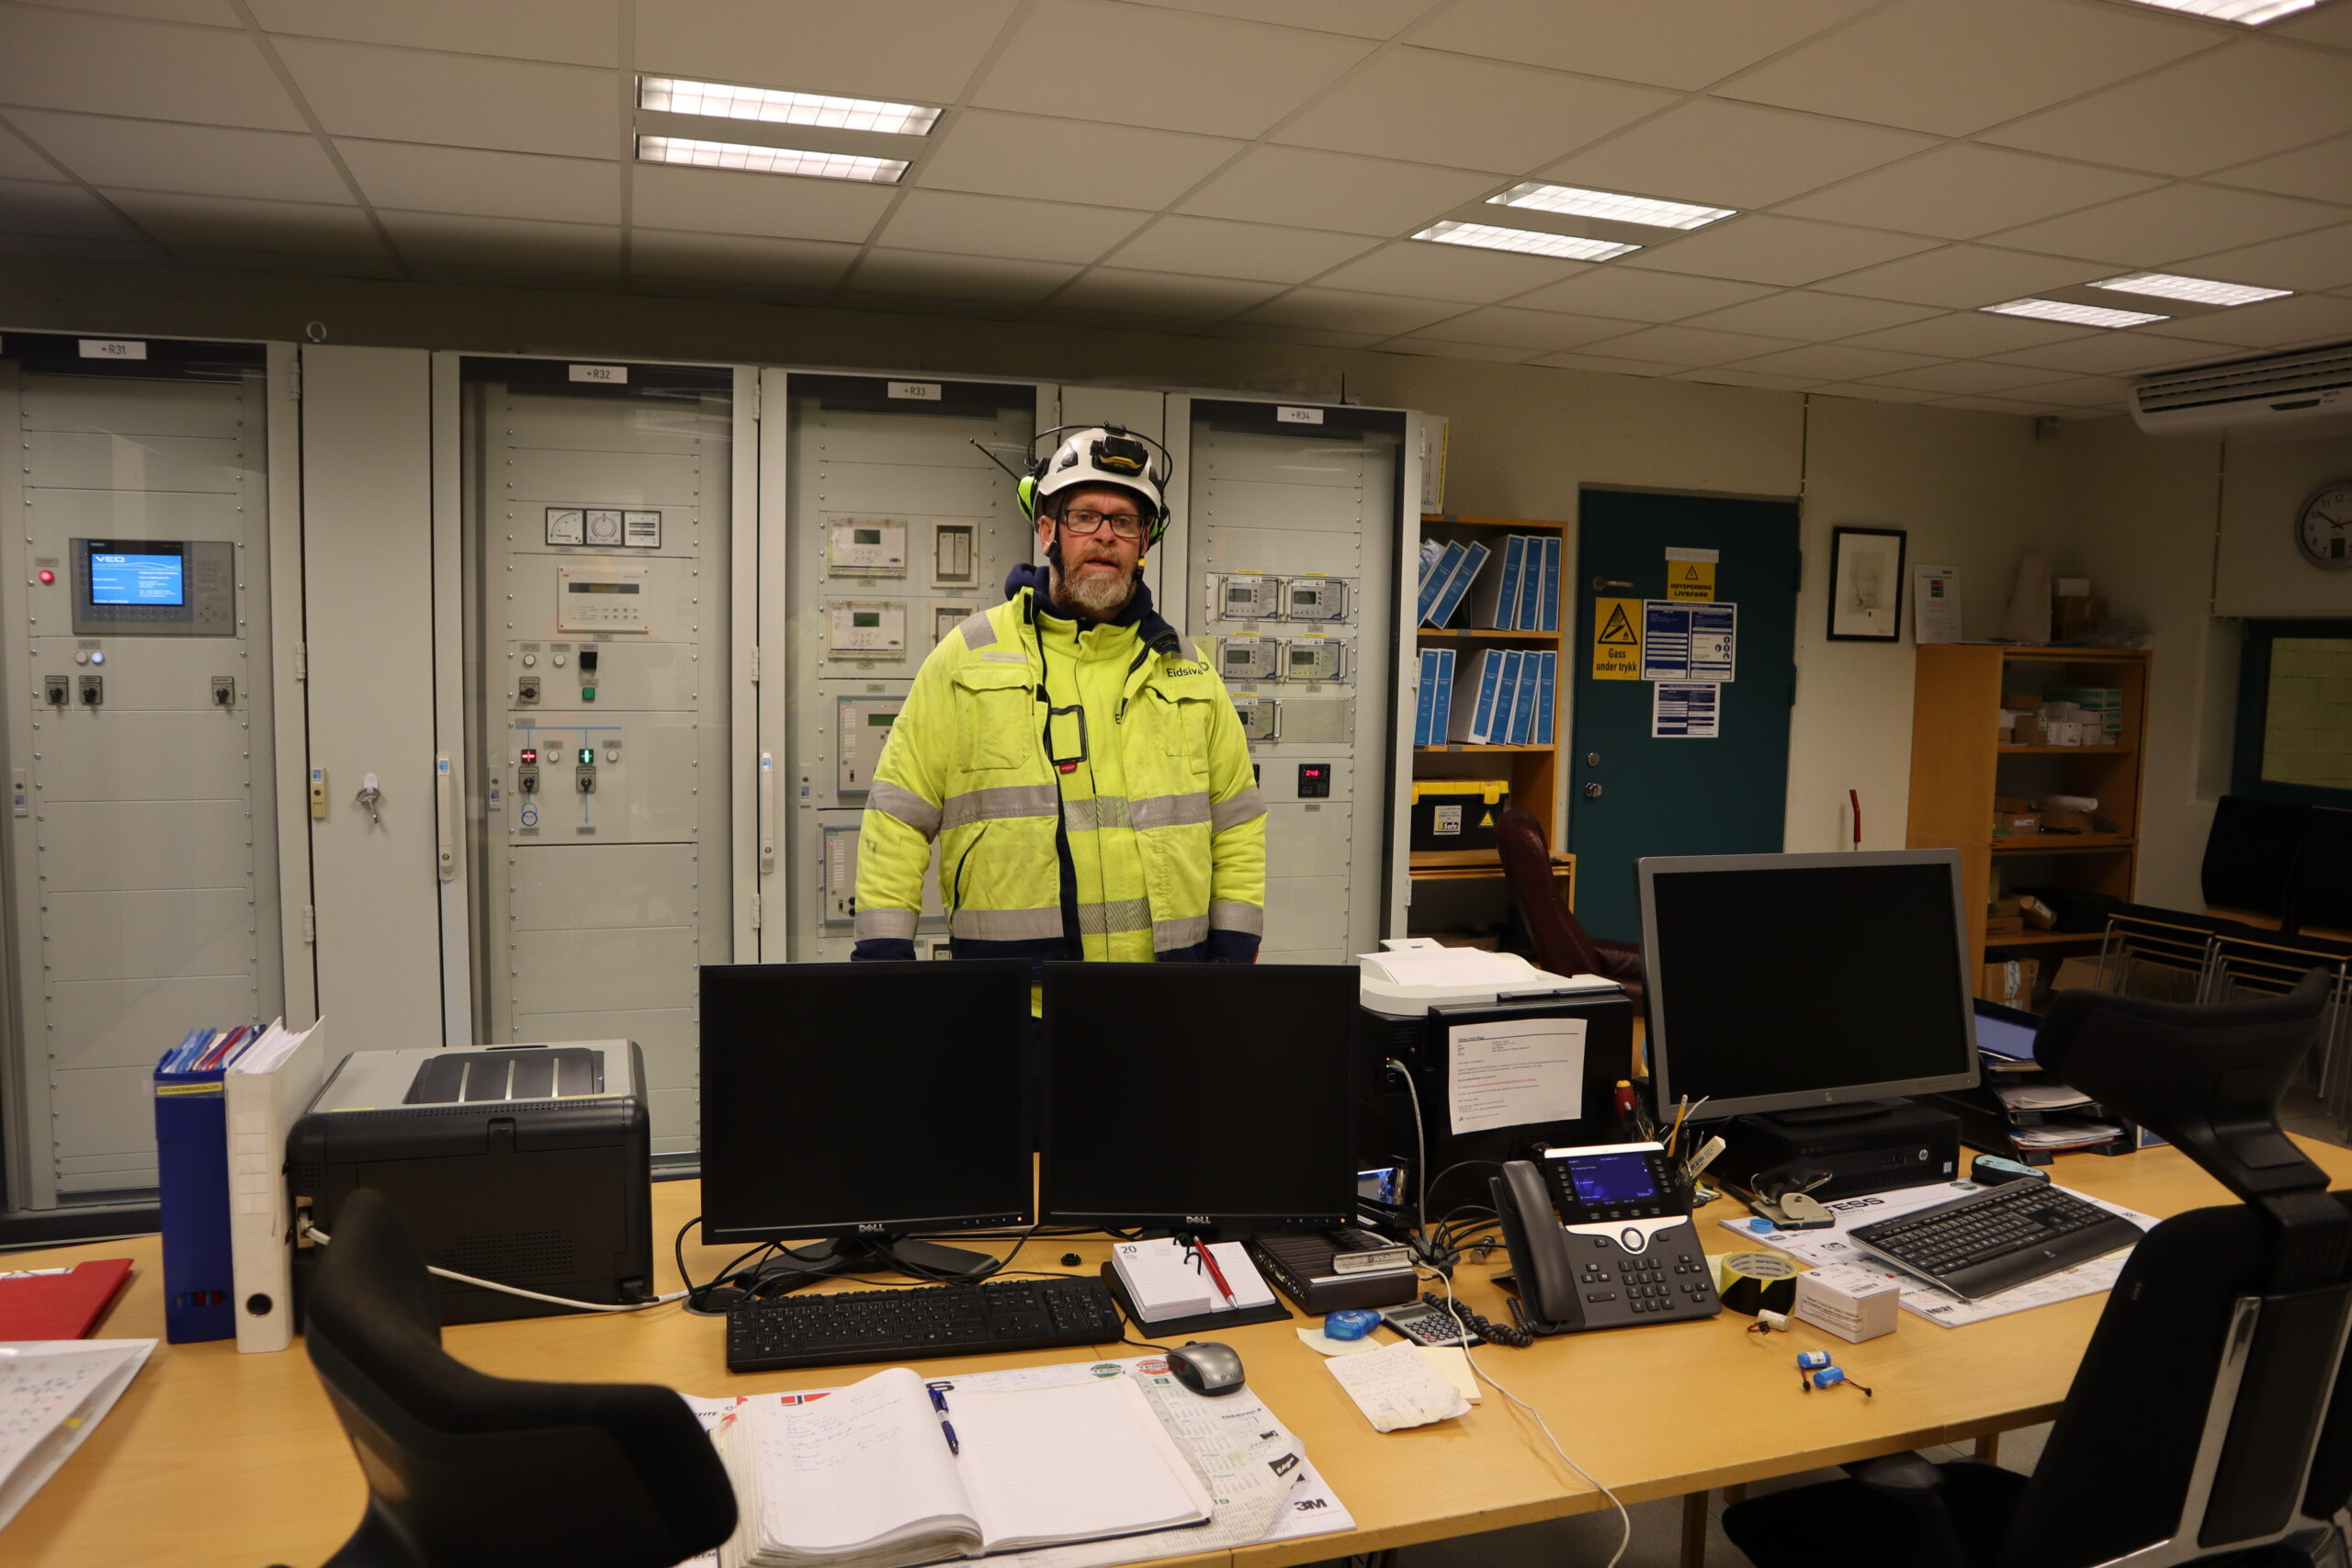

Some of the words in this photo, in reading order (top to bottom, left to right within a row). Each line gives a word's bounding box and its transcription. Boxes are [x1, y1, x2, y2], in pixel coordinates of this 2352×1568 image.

[586, 369, 611, 379] +R32
[904, 387, 926, 396] +R33
[1291, 411, 1310, 420] +R34
[1609, 648, 1626, 659] Gass
[1596, 661, 1618, 671] under
[1619, 661, 1637, 674] trykk
[1167, 668, 1203, 678] Eidsiva
[1185, 1215, 1212, 1224] DELL
[858, 1223, 885, 1233] DELL
[1120, 1246, 1137, 1255] 20
[1294, 1498, 1329, 1511] 3M
